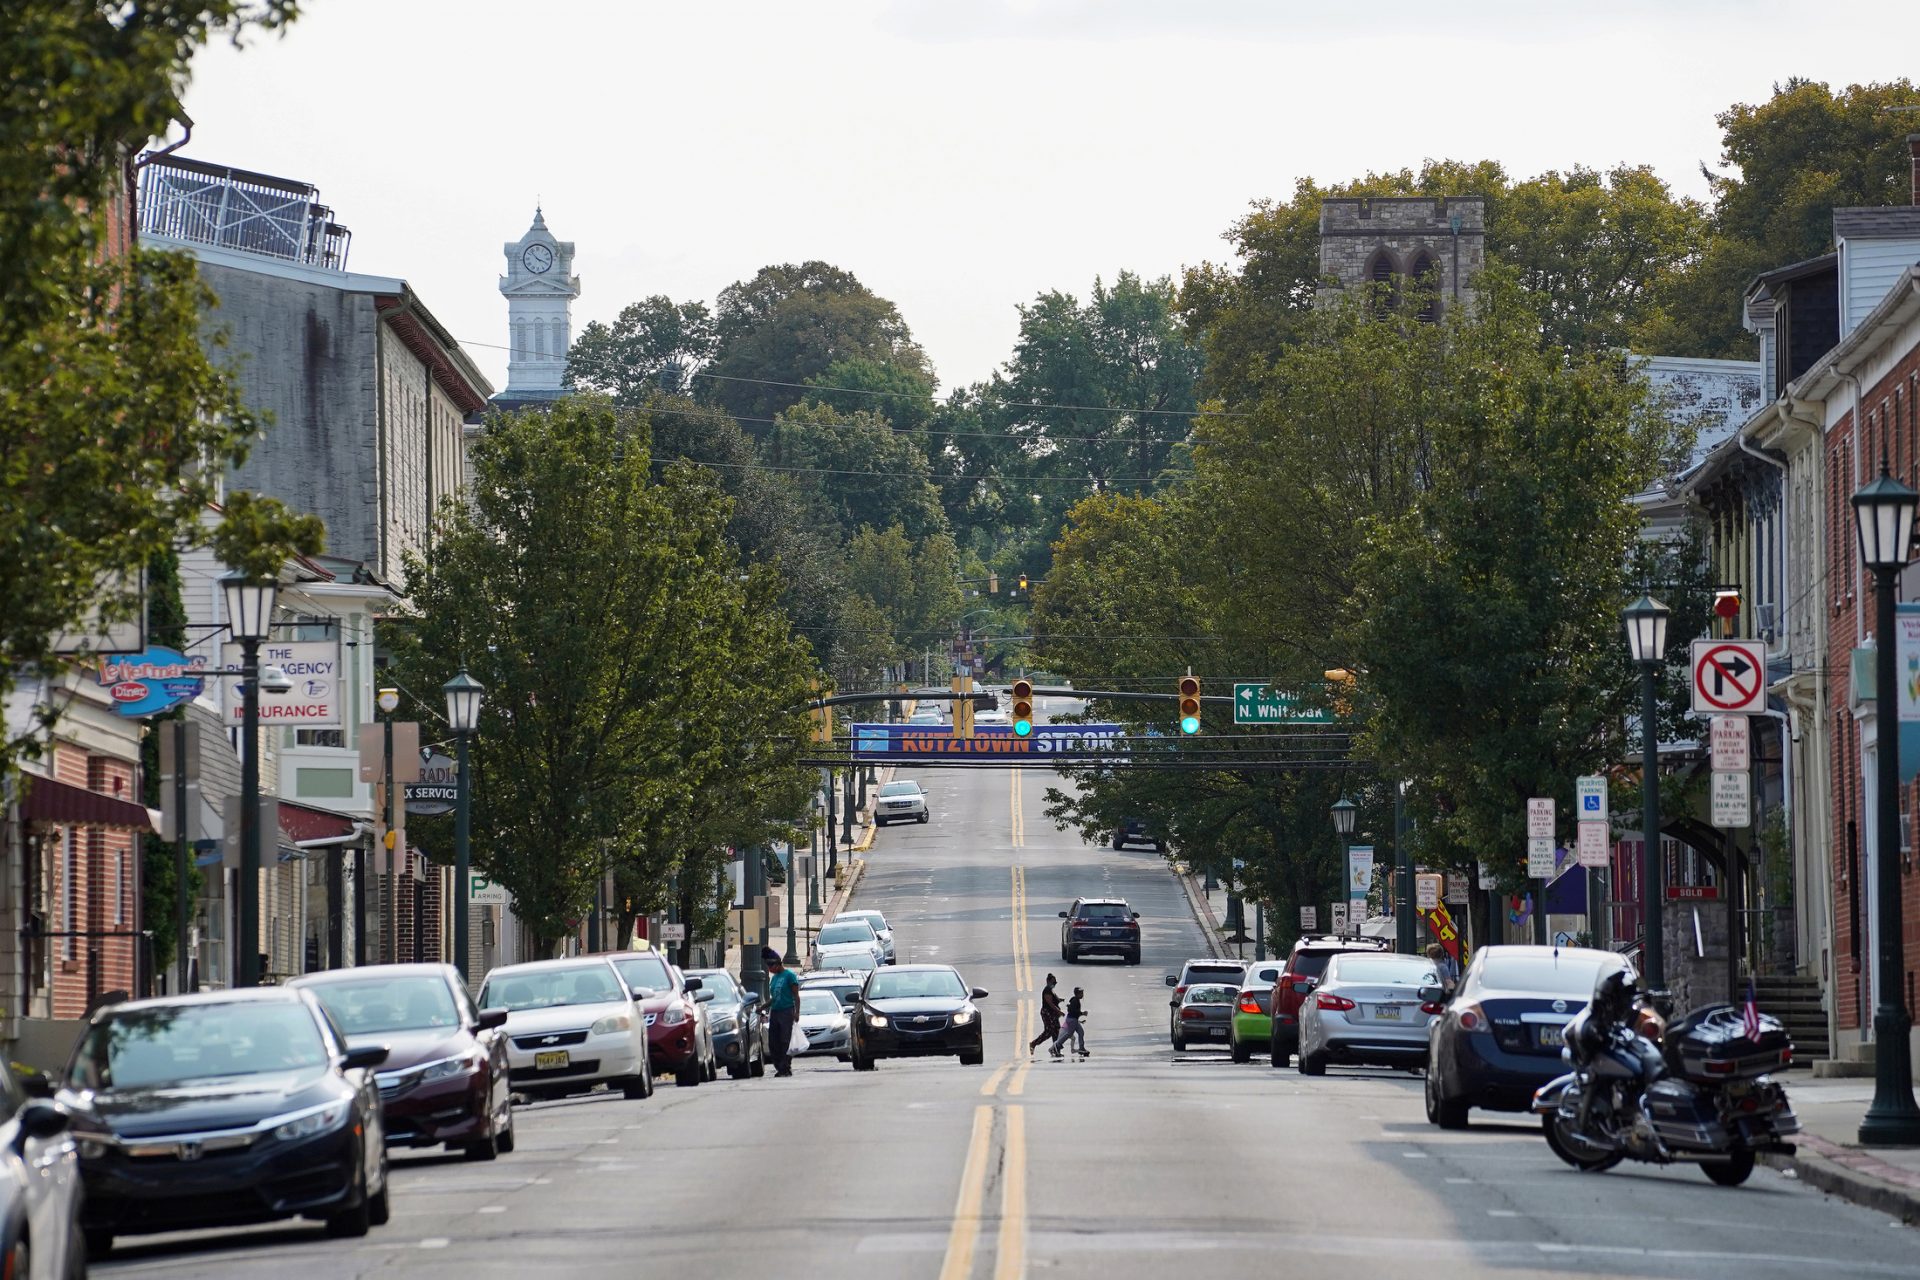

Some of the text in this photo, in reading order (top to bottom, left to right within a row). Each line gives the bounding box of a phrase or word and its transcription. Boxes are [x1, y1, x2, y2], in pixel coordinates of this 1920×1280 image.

[268, 648, 292, 660] THE
[280, 661, 333, 676] AGENCY
[114, 686, 145, 698] Diner
[1239, 704, 1252, 718] N.
[1724, 719, 1735, 730] NO
[1714, 730, 1746, 740] PARKING
[902, 732, 1030, 752] KUTZTOWN
[1723, 774, 1738, 782] TWO
[1715, 793, 1745, 801] PARKING
[1530, 809, 1553, 817] PARKING
[1680, 888, 1703, 897] SOLD
